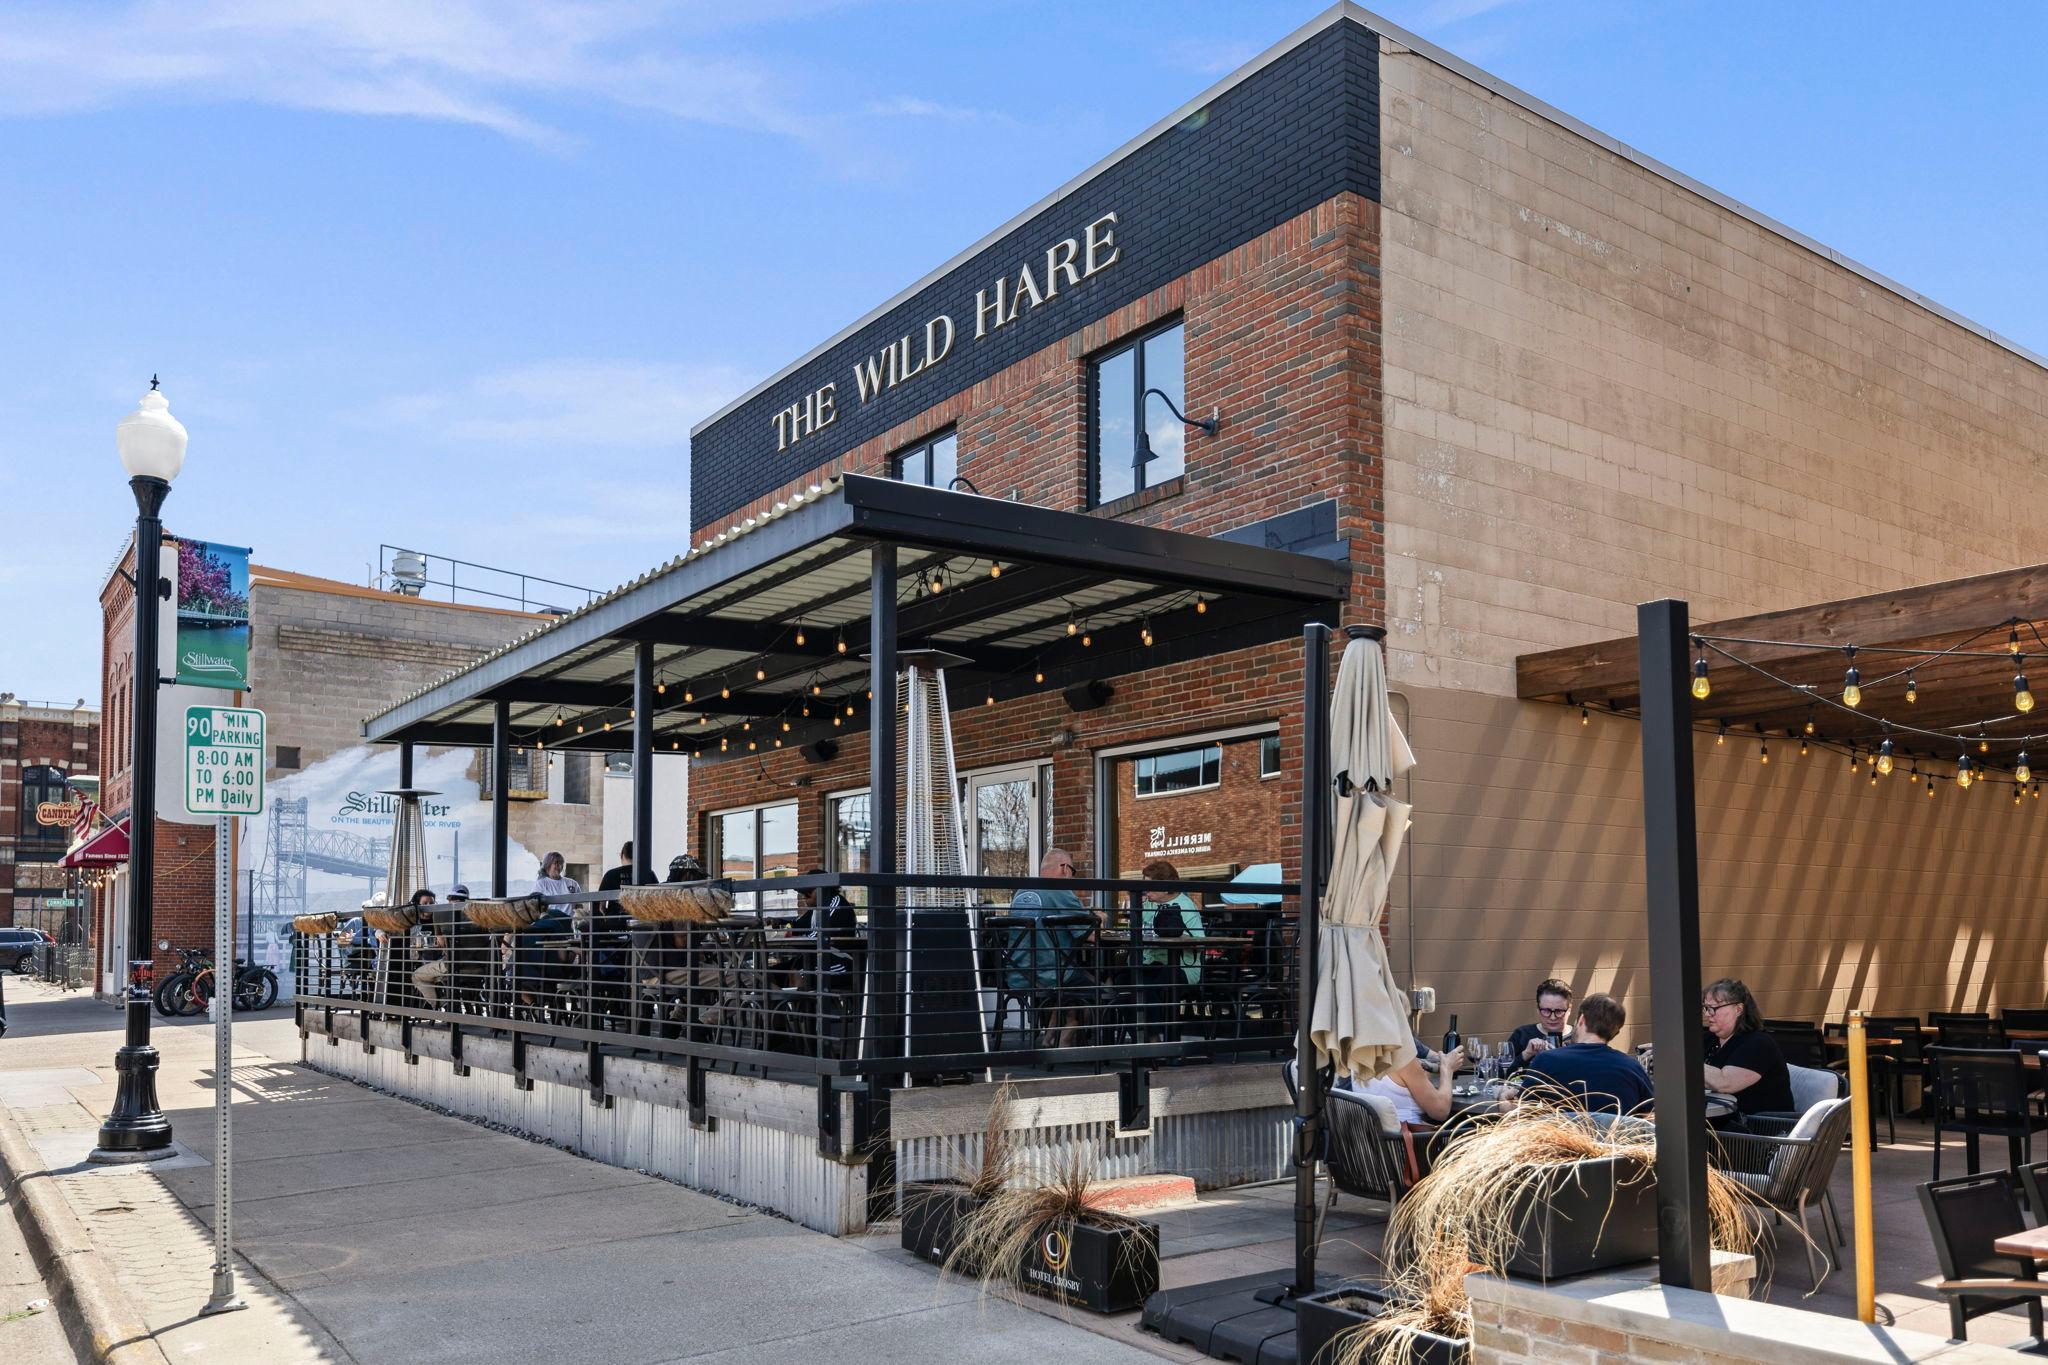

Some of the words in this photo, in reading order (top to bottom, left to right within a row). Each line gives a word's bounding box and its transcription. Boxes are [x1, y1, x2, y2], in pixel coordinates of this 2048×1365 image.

[771, 381, 838, 452] THE
[853, 314, 956, 403] WILD
[973, 211, 1121, 341] HARE
[182, 651, 235, 670] Stillwater
[188, 717, 211, 737] 90
[227, 714, 249, 729] MIN
[212, 730, 260, 745] PARKING
[197, 750, 229, 766] 8:00
[234, 752, 253, 767] AM
[196, 768, 212, 784] TO
[223, 770, 254, 786] 6:00
[196, 788, 214, 804] PM
[221, 788, 253, 809] Daily
[339, 791, 451, 817] Stillter
[42, 808, 77, 819] CANDYLA
[331, 815, 344, 824] ON
[345, 817, 360, 825] THE
[1029, 1268, 1053, 1284] HOTEL
[1052, 1275, 1081, 1292] CROSBY
